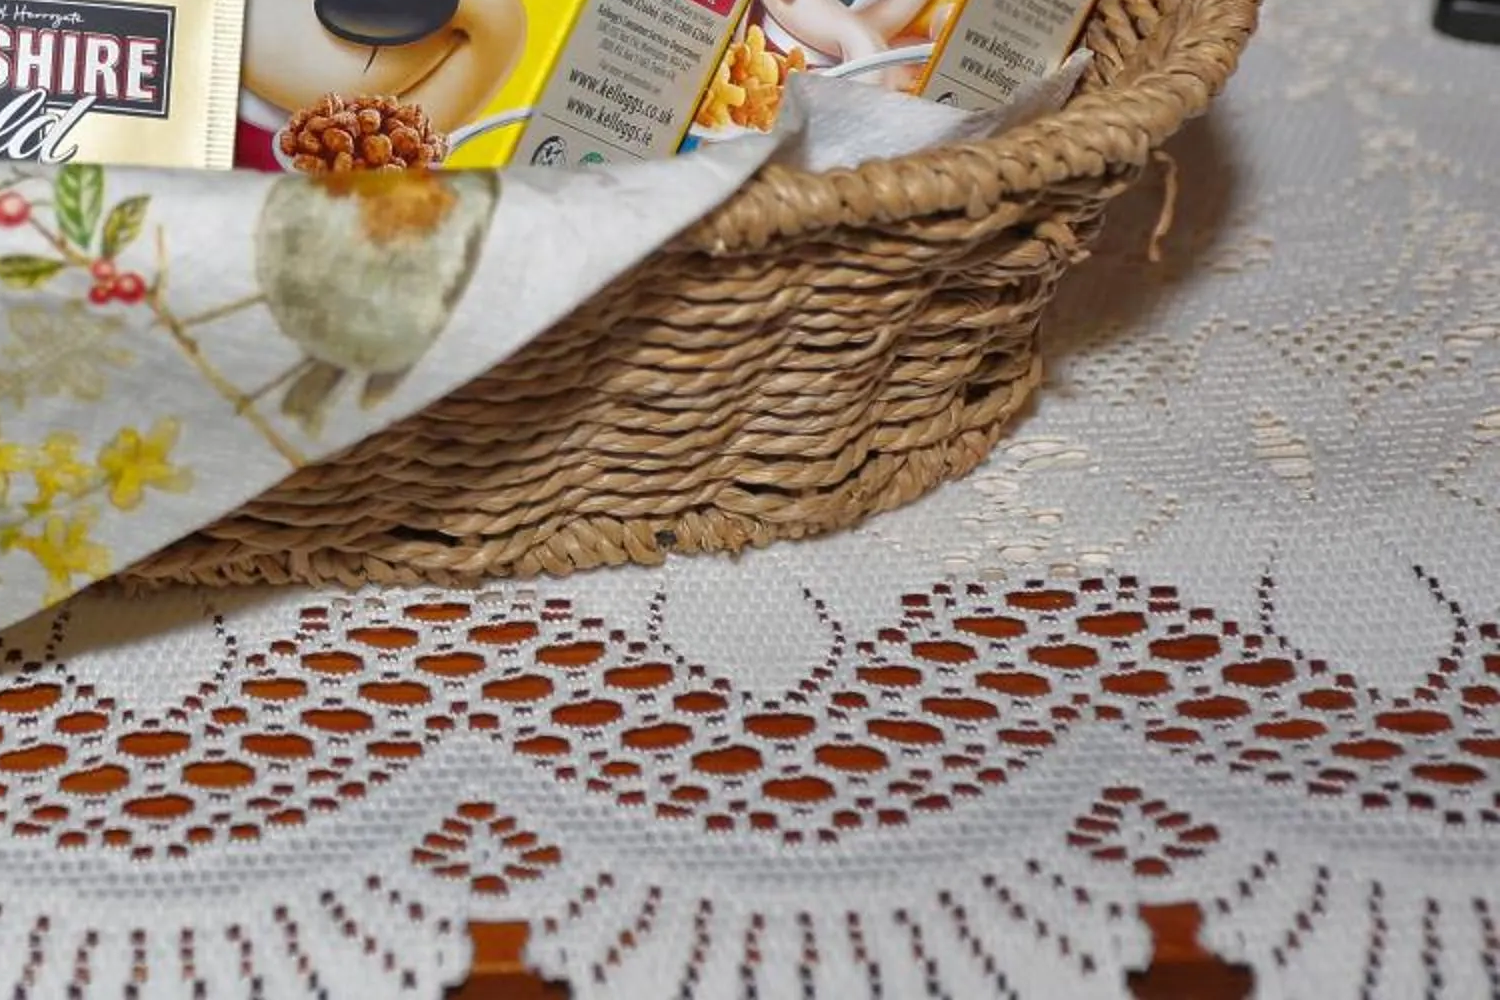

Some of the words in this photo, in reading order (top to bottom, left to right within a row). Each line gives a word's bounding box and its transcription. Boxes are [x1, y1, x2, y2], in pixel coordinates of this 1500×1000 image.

[12, 4, 85, 29] Harrogate
[565, 96, 654, 146] www.kelloggs.ie
[568, 67, 675, 126] www.kelloggs.co.uk
